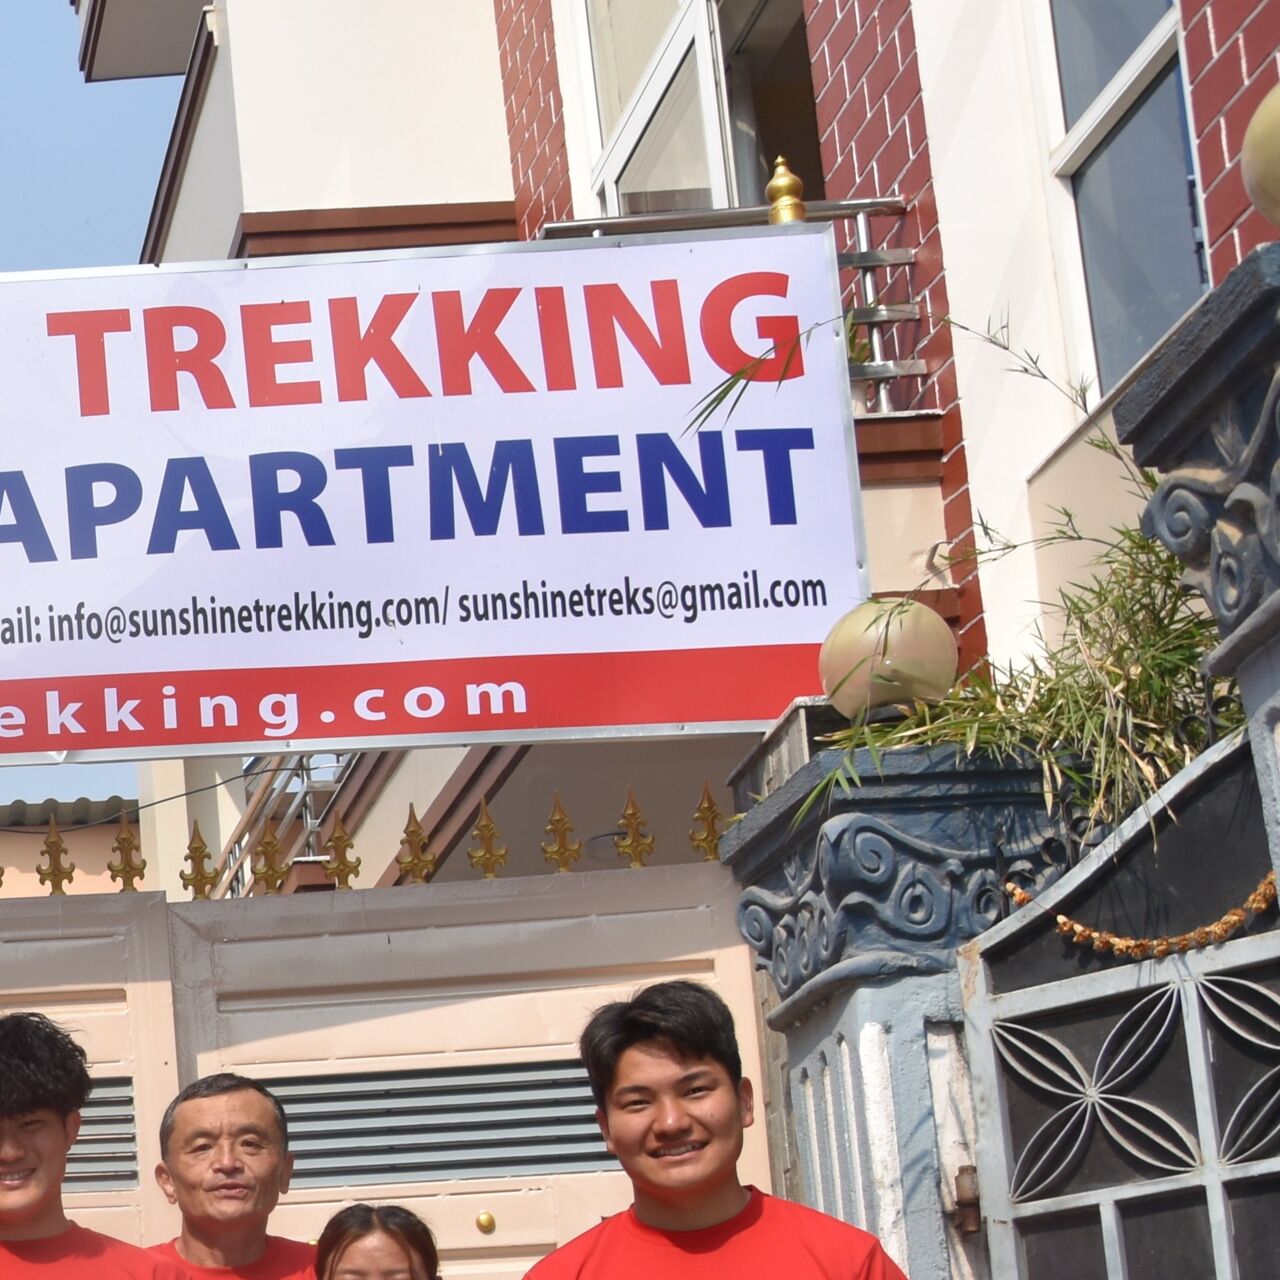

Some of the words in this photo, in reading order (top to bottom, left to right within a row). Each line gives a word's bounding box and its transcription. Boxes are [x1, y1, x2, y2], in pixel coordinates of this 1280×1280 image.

[48, 272, 804, 415] TREKKING
[49, 586, 448, 643] info@sunshinetrekking.com/
[459, 570, 826, 623] sunshinetreks@gmail.com
